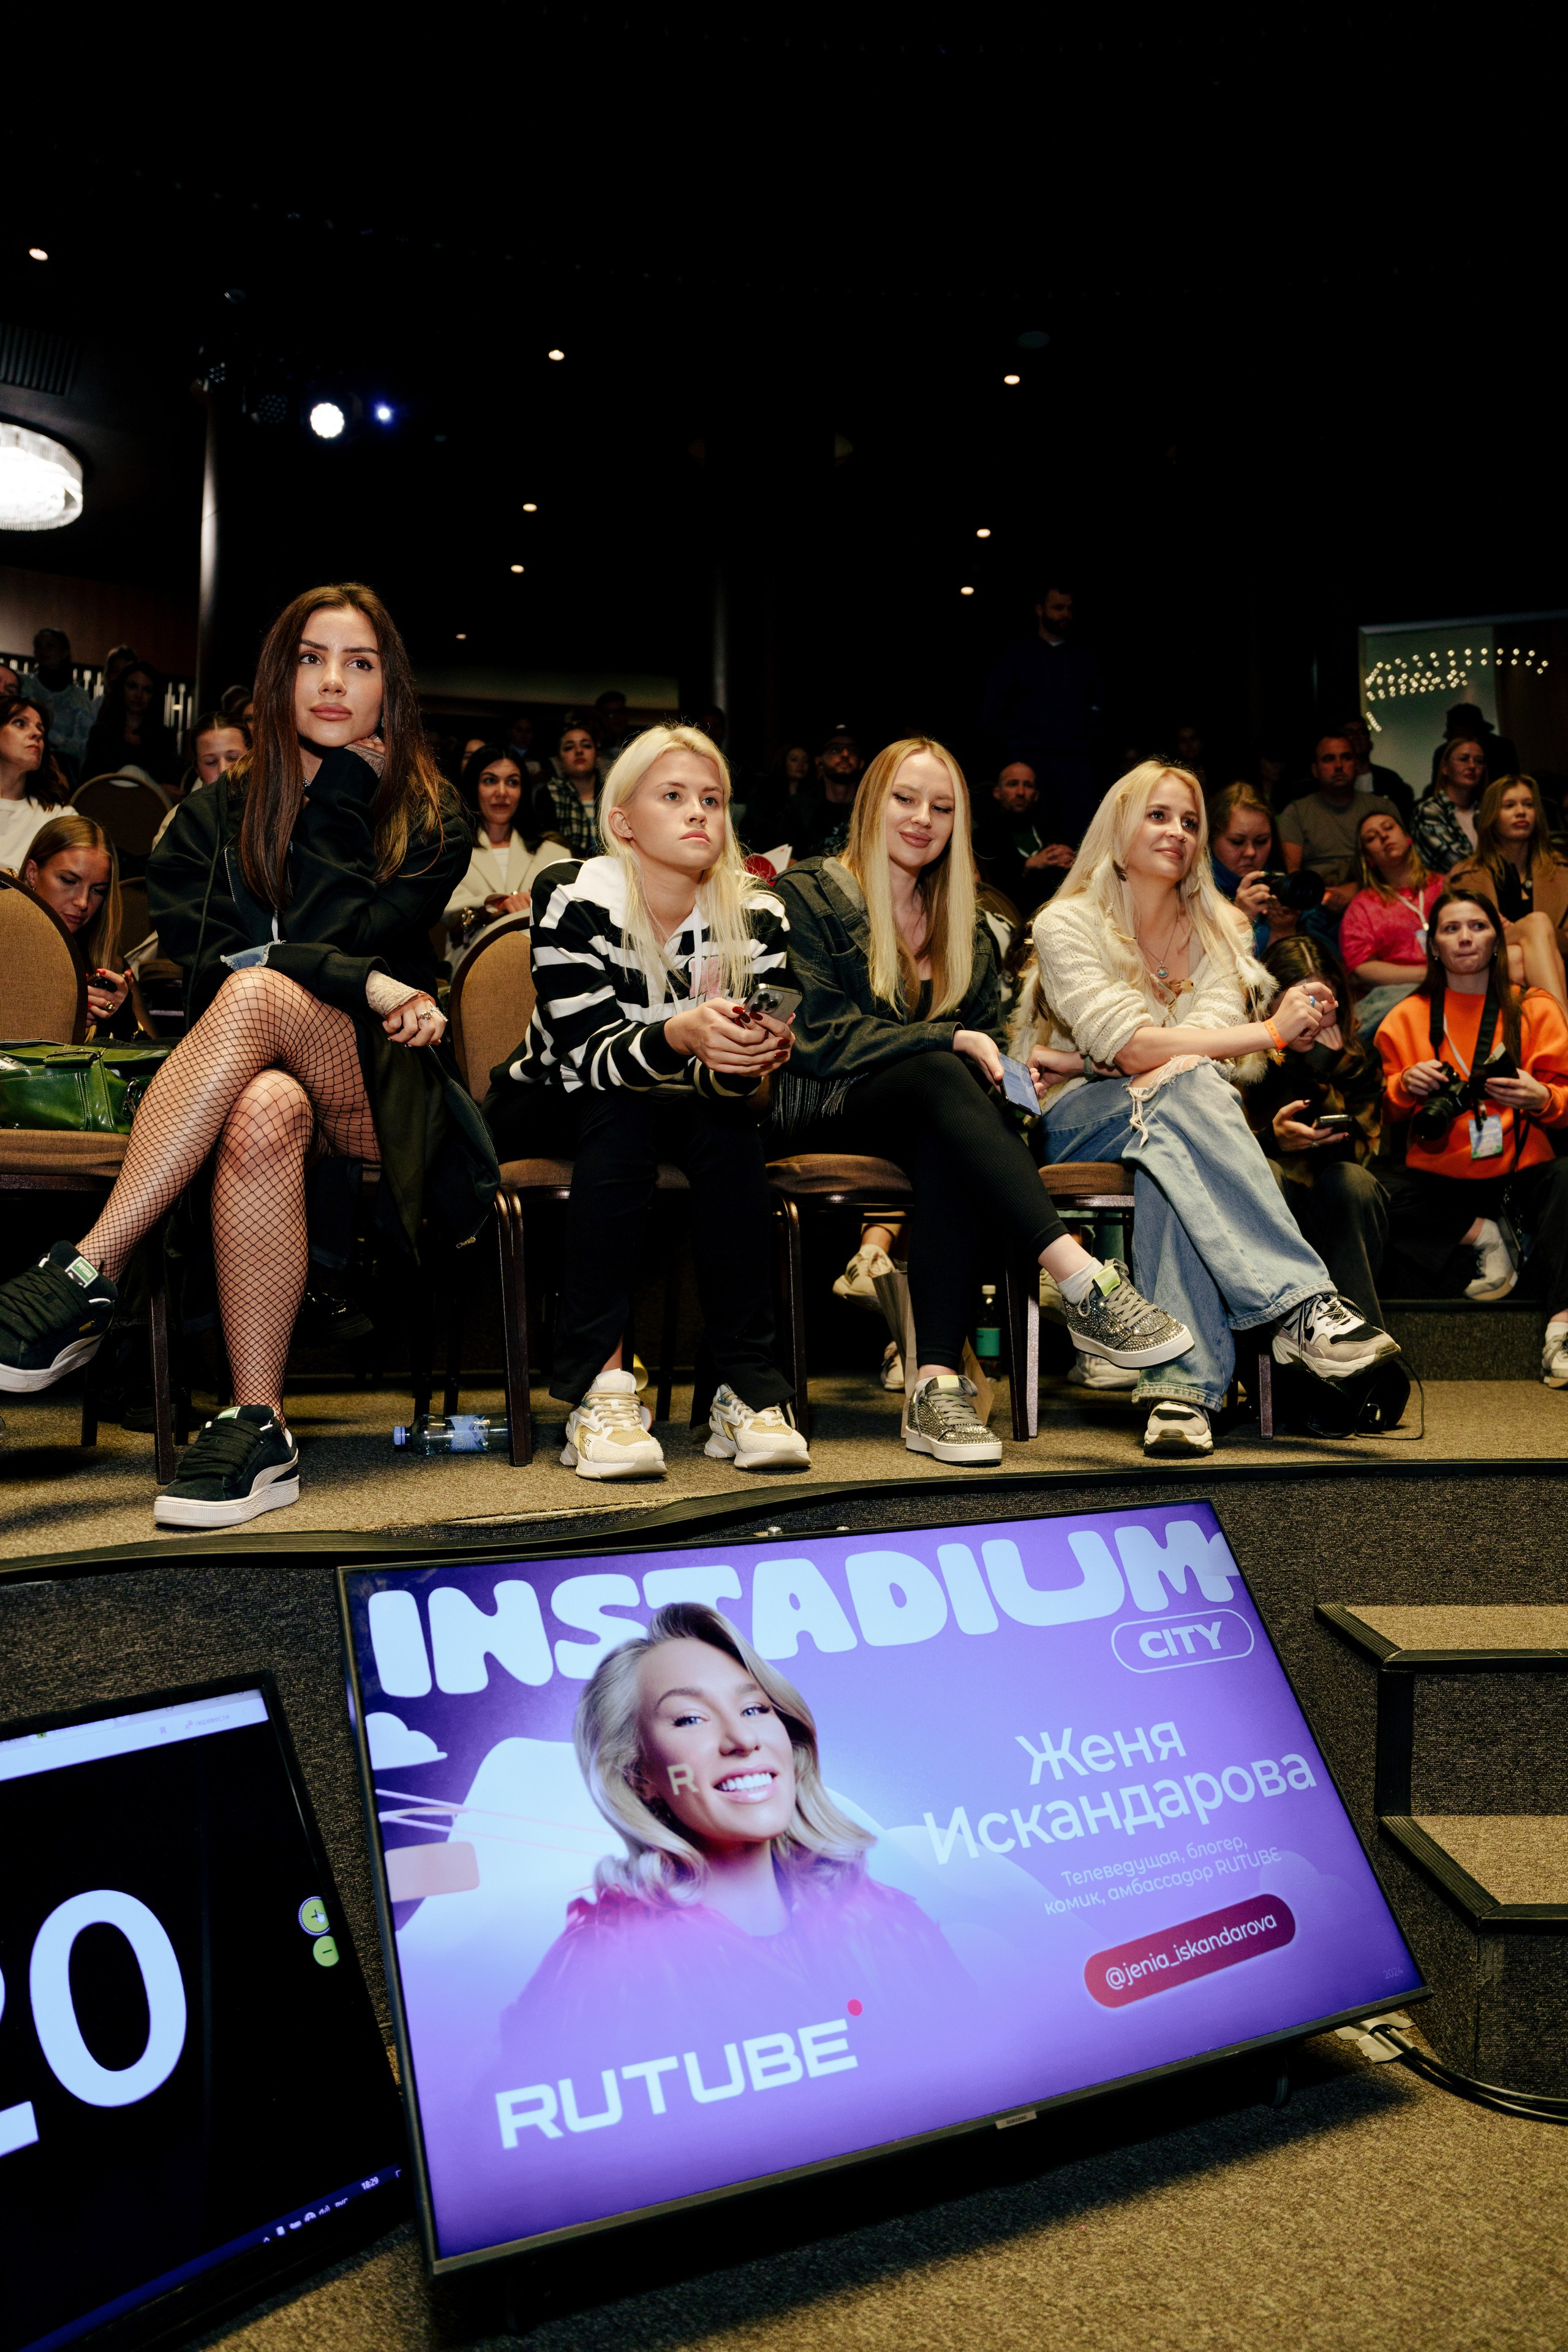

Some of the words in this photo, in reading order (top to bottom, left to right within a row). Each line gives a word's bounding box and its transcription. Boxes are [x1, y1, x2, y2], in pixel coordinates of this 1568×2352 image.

[368, 1520, 1238, 1698] INSTADIUM
[1139, 1622, 1221, 1658] CITY
[667, 1765, 698, 1795] R
[1015, 1722, 1186, 1785] Женя
[924, 1754, 1317, 1863] Искандарова
[1044, 1891, 1105, 1915] комик,
[1108, 1866, 1213, 1901] амбассадор
[1216, 1847, 1282, 1875] RUTUBE
[1061, 1851, 1186, 1886] Телеведущая,
[1187, 1836, 1247, 1858] блогер,
[1106, 1913, 1277, 1990] @jenia_iskandarova
[1382, 1966, 1403, 1979] 2024
[495, 2018, 859, 2149] RUTUBE
[361, 2176, 379, 2190] 18:29
